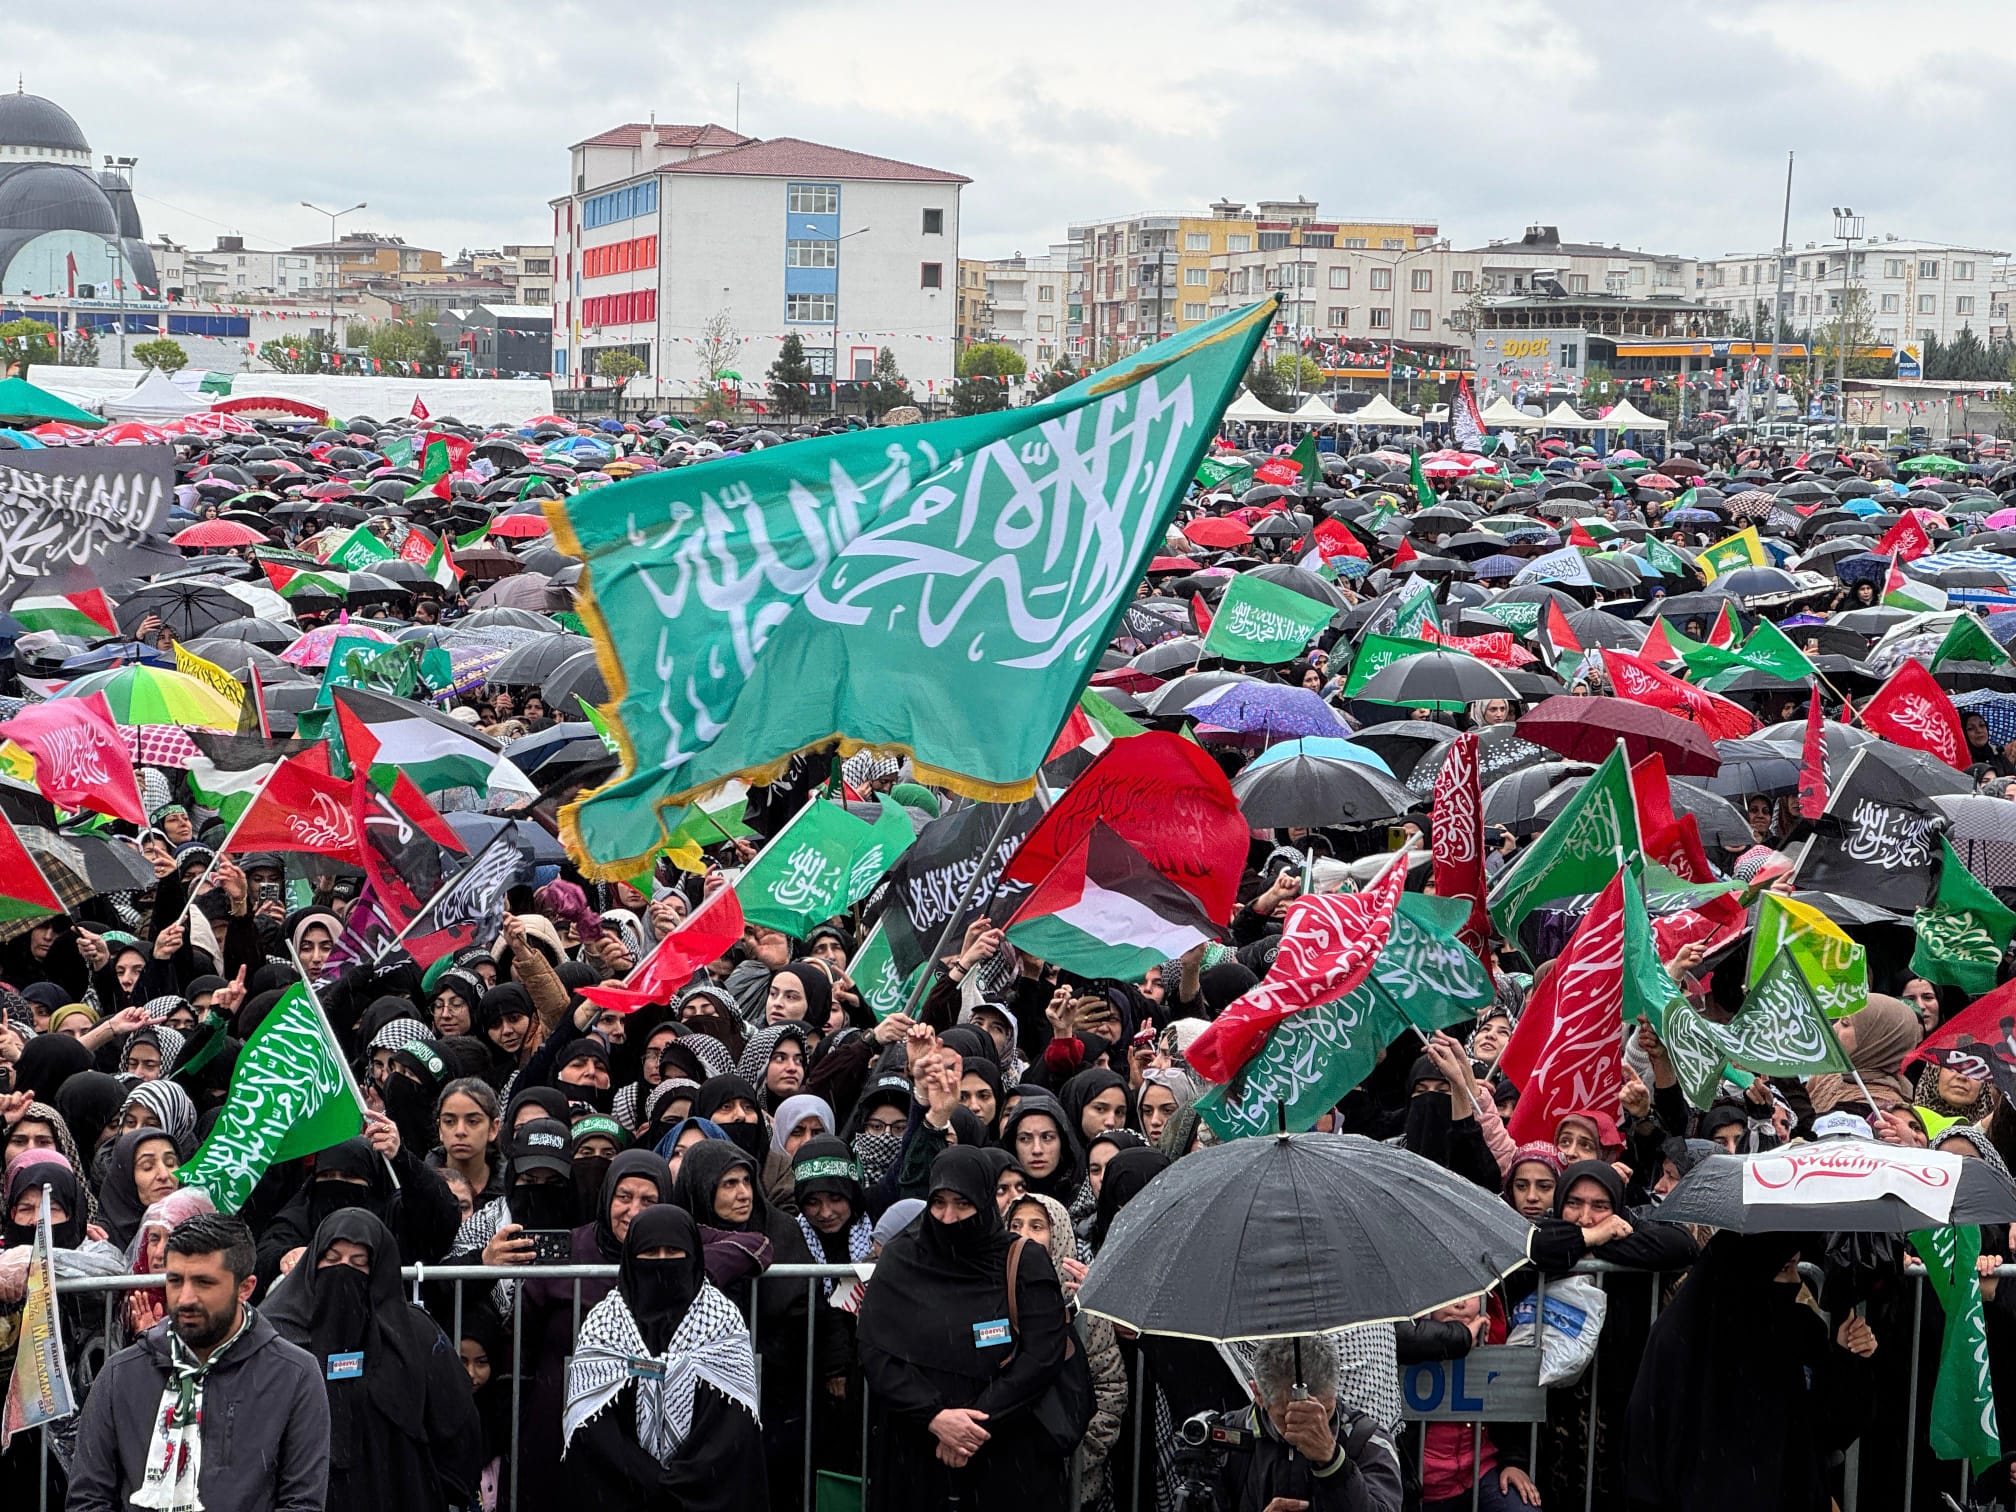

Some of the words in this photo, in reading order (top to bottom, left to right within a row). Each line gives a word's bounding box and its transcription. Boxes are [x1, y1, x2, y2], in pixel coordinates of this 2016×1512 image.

[1502, 337, 1551, 359] opet
[31, 1323, 56, 1416] MUHAMMED
[50, 1341, 63, 1380] RAHMET
